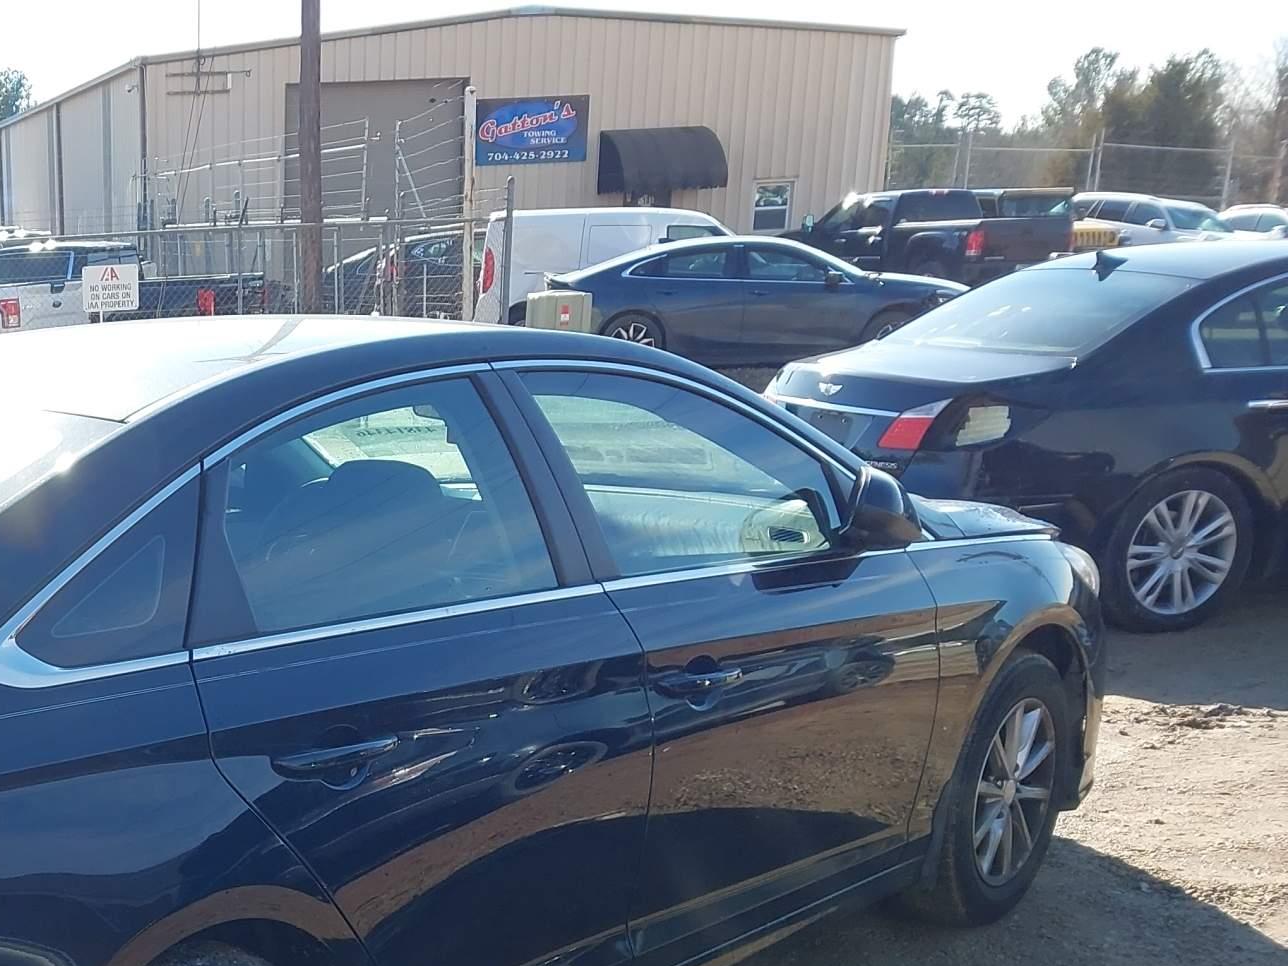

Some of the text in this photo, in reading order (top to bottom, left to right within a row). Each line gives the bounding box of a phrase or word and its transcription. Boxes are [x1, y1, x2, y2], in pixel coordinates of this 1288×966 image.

[479, 101, 576, 142] Gatton's
[523, 130, 557, 138] TOWING
[530, 137, 567, 145] SERVICE
[487, 150, 569, 161] 704-425-2922
[89, 283, 132, 292] NO WORKING
[102, 292, 120, 300] CARS
[88, 299, 134, 309] IAA PROPERTY
